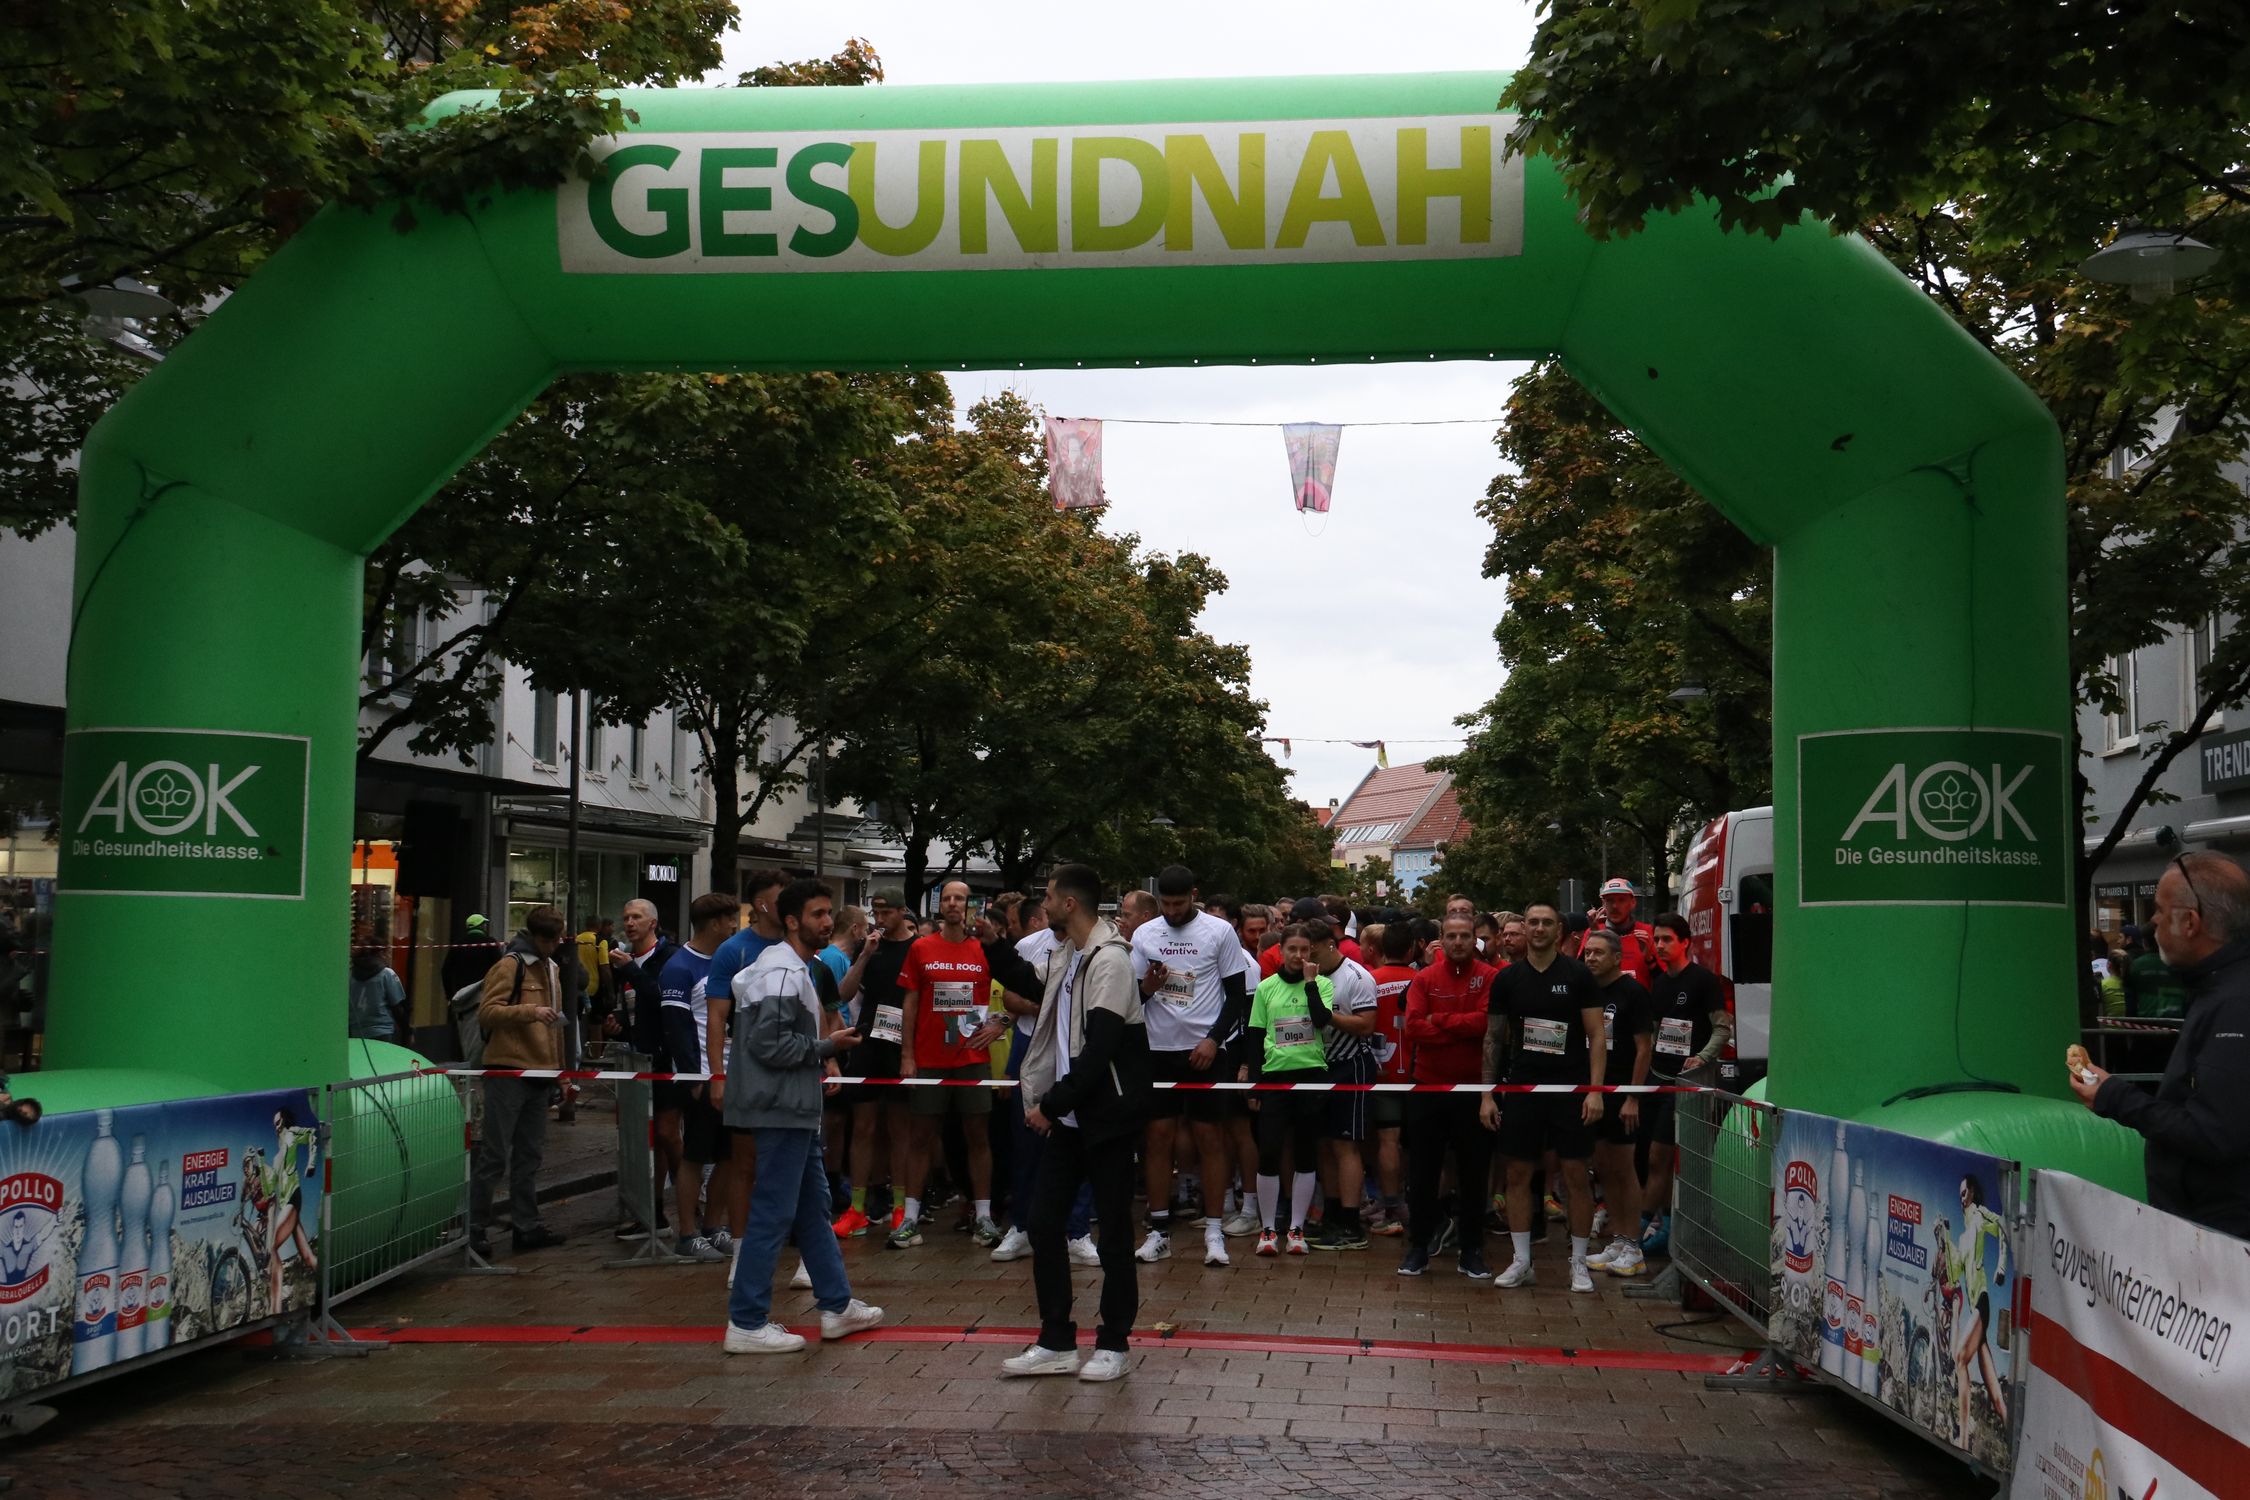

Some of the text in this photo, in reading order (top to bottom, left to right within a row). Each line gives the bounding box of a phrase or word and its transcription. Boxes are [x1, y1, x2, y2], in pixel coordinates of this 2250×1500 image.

[588, 126, 1491, 258] GESUNDNAH
[77, 760, 262, 837] AOK
[1839, 761, 2039, 841] AOK
[73, 839, 263, 860] Die Gesundheitskasse.
[1835, 847, 2042, 866] Die Gesundheitskasse.
[648, 864, 677, 882] BROKKOLI
[1159, 947, 1198, 955] Vantive
[925, 960, 982, 972] MÖBEL ROGG
[1162, 983, 1187, 993] erhat
[1469, 975, 1484, 989] 90
[1551, 984, 1568, 993] AKE
[934, 997, 971, 1007] Benjamin
[878, 1019, 902, 1031] Morit
[1284, 1032, 1304, 1042] Olga
[1659, 1031, 1686, 1043] Samuel
[186, 1151, 225, 1170] ENERGIE
[184, 1170, 215, 1189] KRAFT
[1786, 1166, 1816, 1196] POLLO
[183, 1185, 234, 1207] AUSDAUER
[1890, 1197, 1920, 1221] ENERGIE
[1889, 1217, 1913, 1239] KRAFT
[1888, 1238, 1925, 1267] AUSDAUER
[2101, 1251, 2231, 1367] Unternehmen
